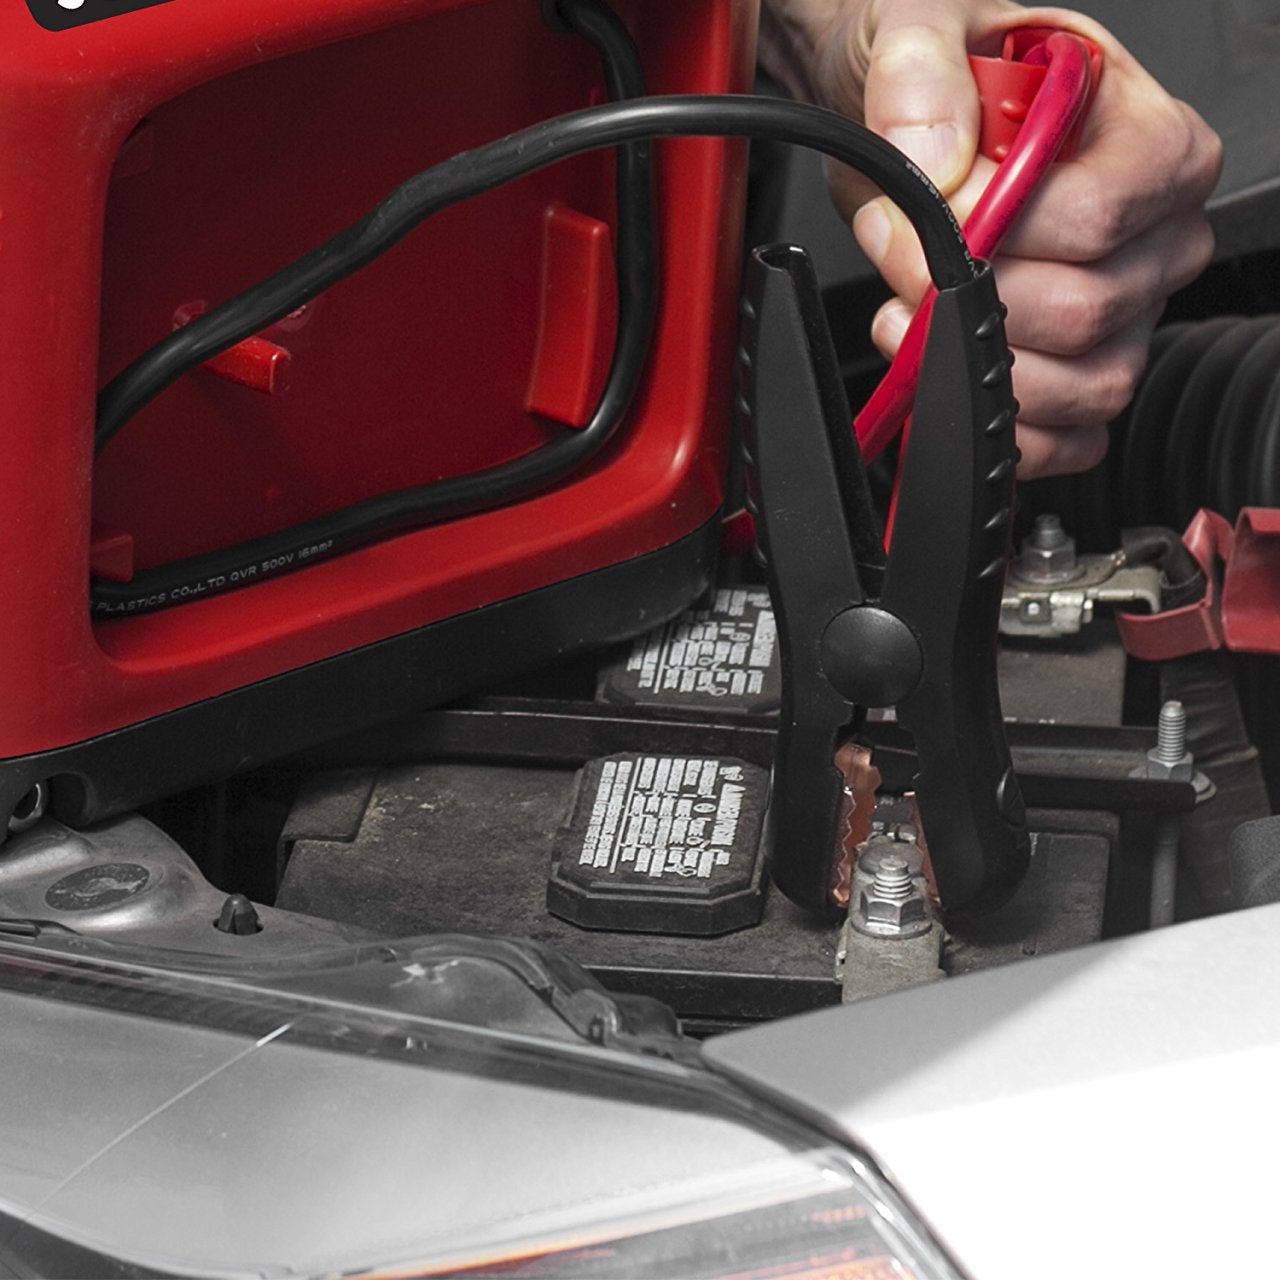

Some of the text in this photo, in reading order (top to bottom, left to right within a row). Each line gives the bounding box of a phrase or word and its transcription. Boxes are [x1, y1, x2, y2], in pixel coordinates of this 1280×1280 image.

[96, 593, 166, 612] PLASTICS
[230, 565, 257, 582] QVR
[261, 553, 294, 572] 500V
